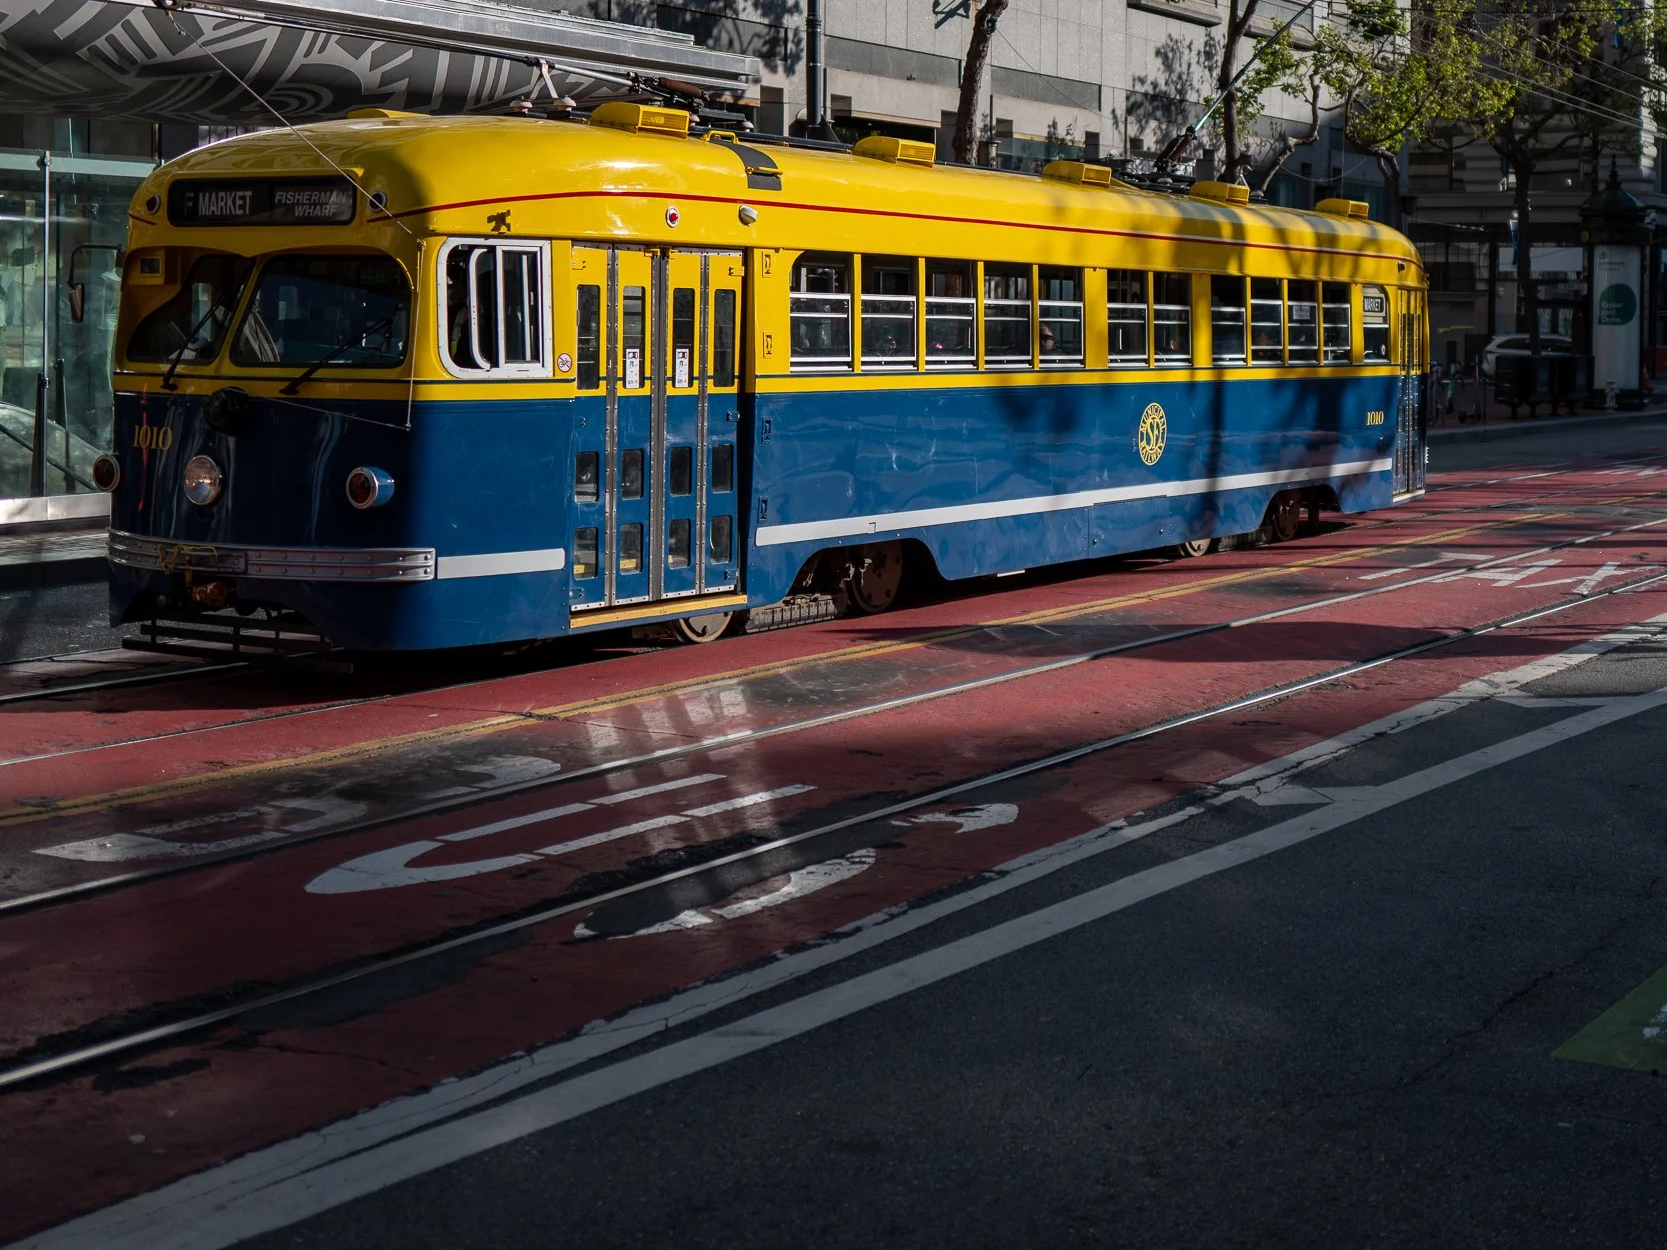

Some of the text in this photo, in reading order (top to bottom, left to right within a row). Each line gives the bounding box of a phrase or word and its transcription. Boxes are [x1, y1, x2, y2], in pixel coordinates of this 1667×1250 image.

[199, 191, 252, 215] MARKET
[295, 205, 338, 217] WHARF
[1364, 297, 1381, 312] MARKET
[1366, 411, 1384, 425] 1010
[132, 424, 173, 451] 1010
